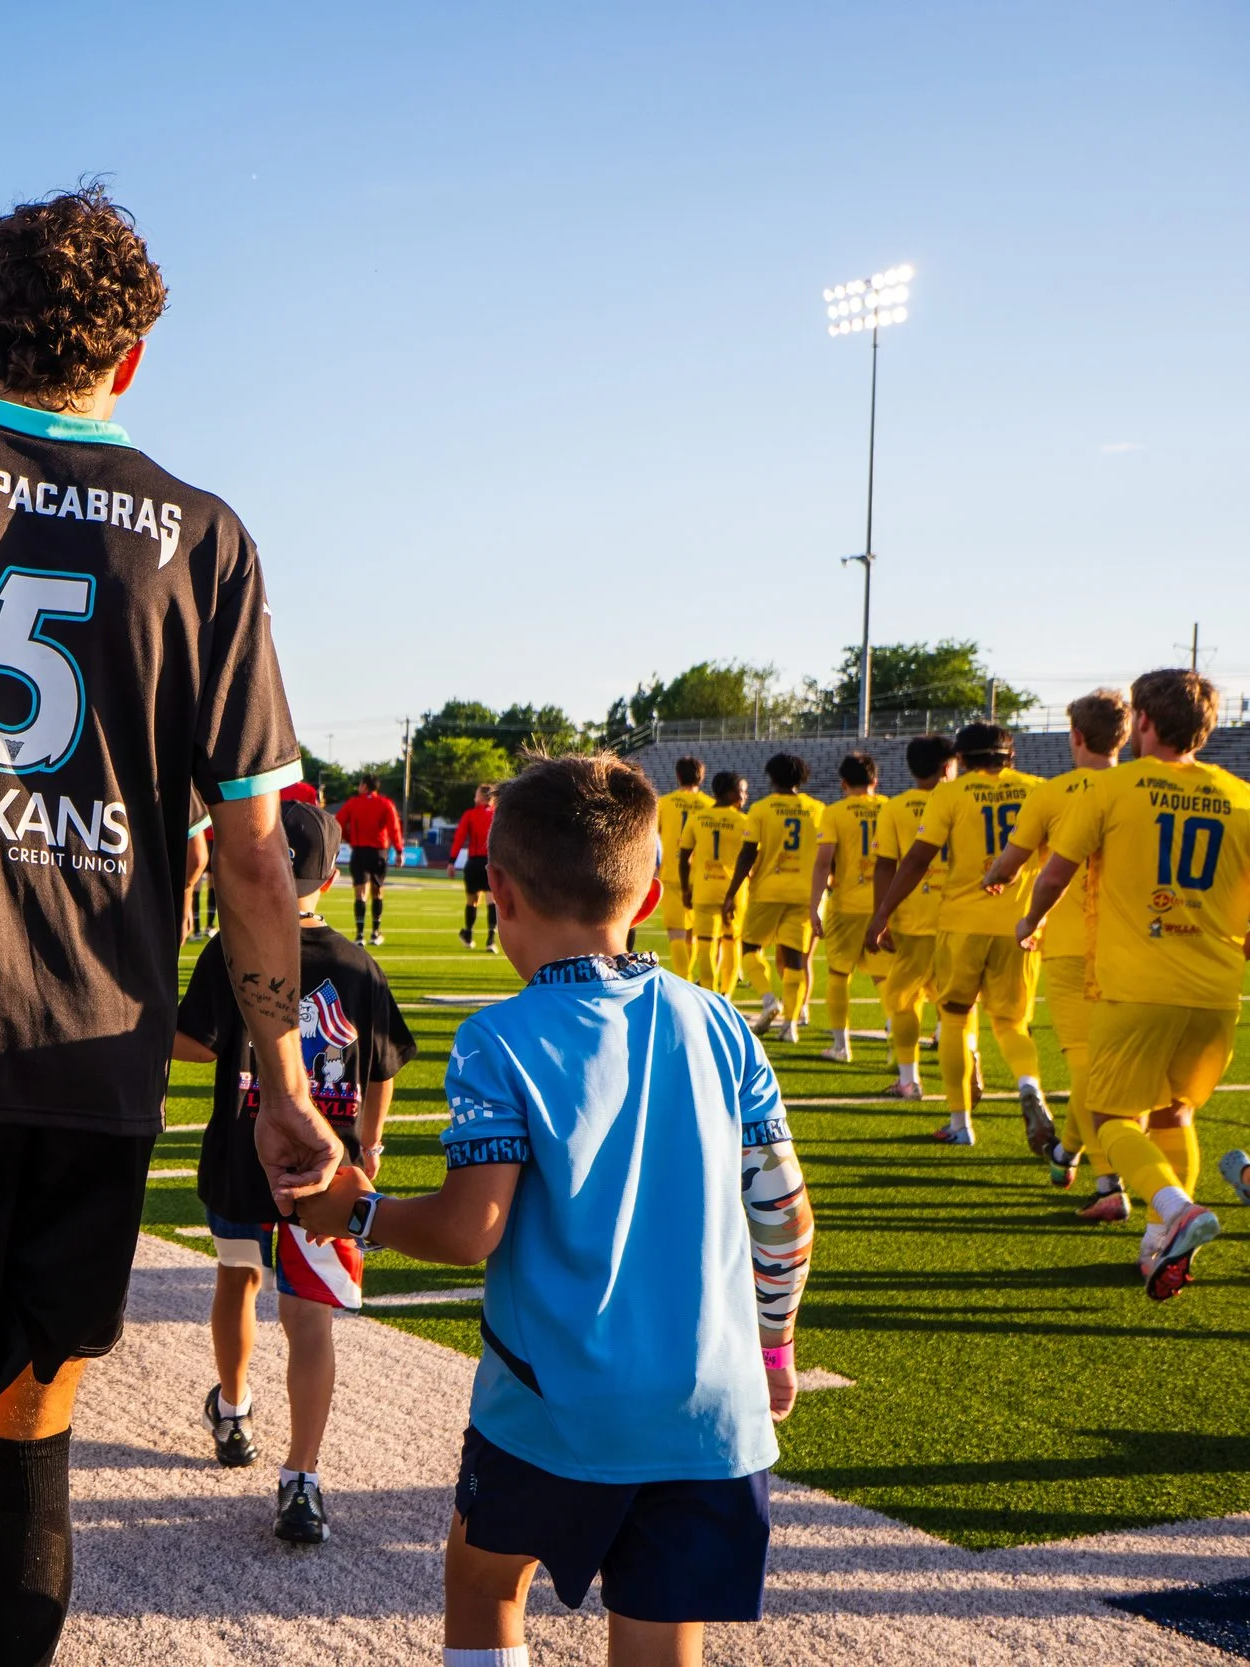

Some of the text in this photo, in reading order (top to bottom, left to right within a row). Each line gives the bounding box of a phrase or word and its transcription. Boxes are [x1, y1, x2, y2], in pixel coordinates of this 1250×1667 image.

[1150, 791, 1232, 815] VAQUEROS
[783, 818, 801, 852] 3
[8, 847, 128, 875] CREDIT UNION
[1155, 812, 1224, 892] 10
